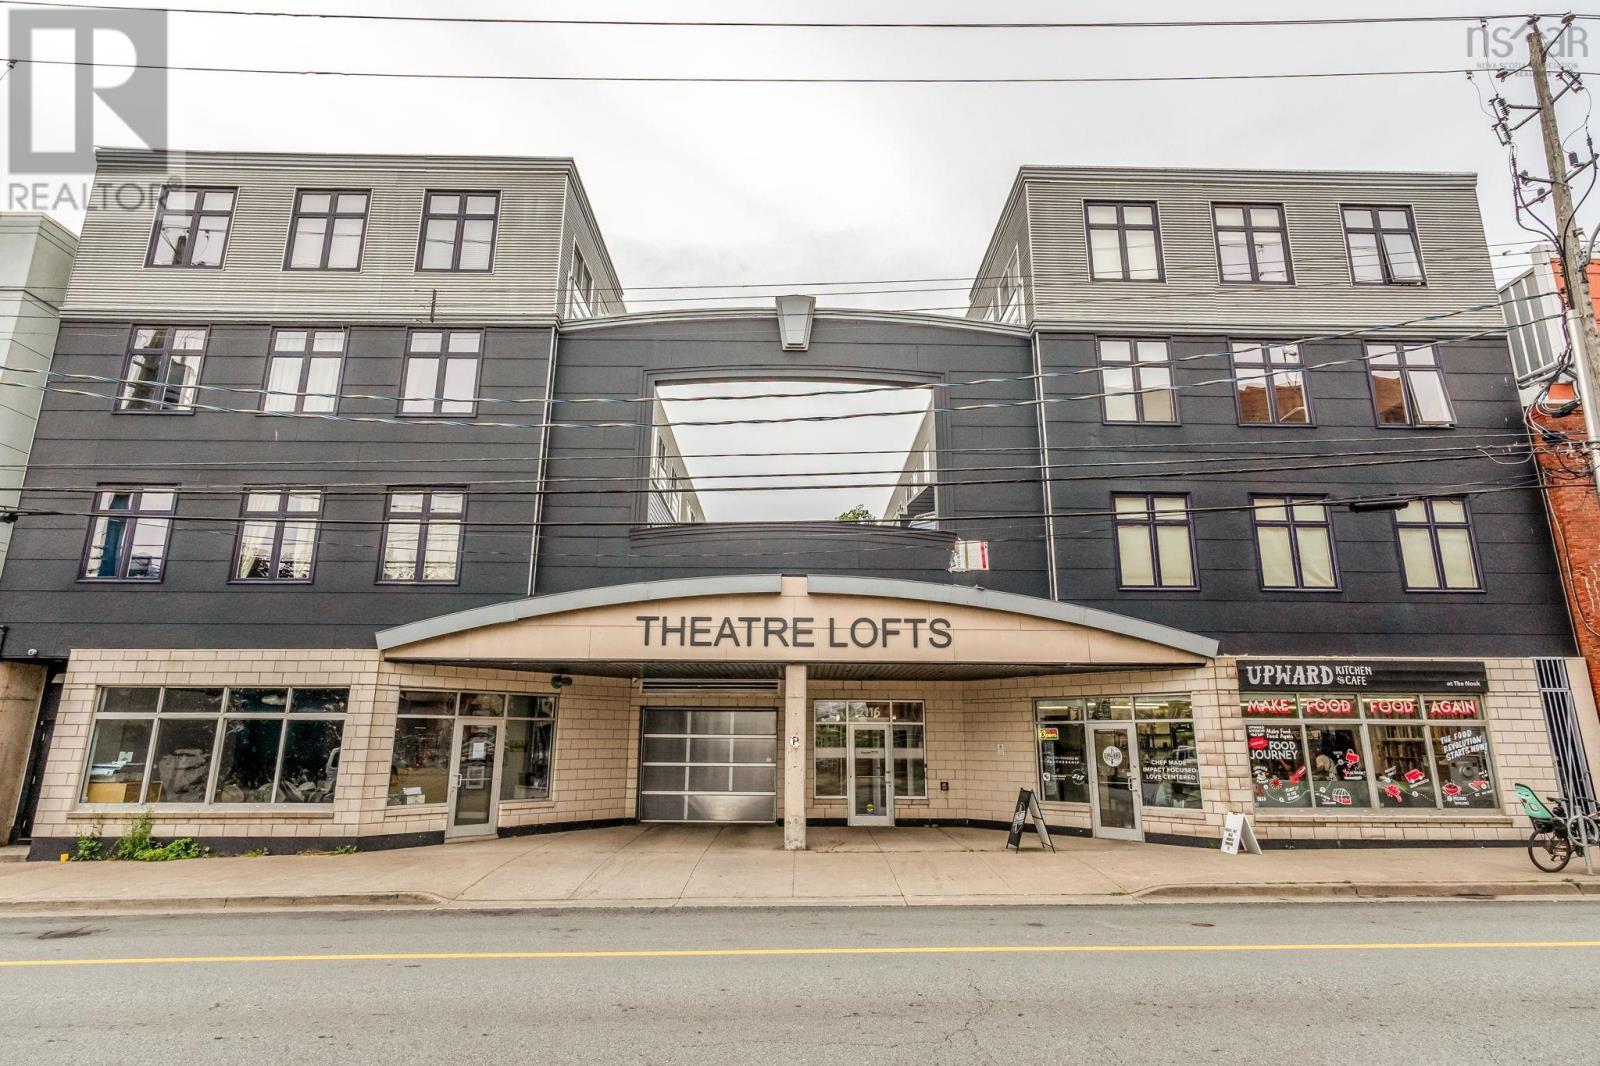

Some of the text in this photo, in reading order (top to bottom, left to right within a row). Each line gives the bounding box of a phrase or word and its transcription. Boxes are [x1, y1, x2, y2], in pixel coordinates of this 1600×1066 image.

[636, 616, 953, 649] THEATRE LOFTS
[1246, 665, 1373, 686] UPWARD KITCHEN
[1345, 676, 1367, 686] CAFE
[1247, 699, 1476, 714] MAKE FOOD FOOD AGAIN
[1440, 729, 1472, 744] THE FOOD
[1269, 740, 1296, 750] FOOD
[1443, 736, 1482, 753] REVOLUTION
[1250, 750, 1298, 760] JOURNEY
[1446, 746, 1470, 761] STARTS
